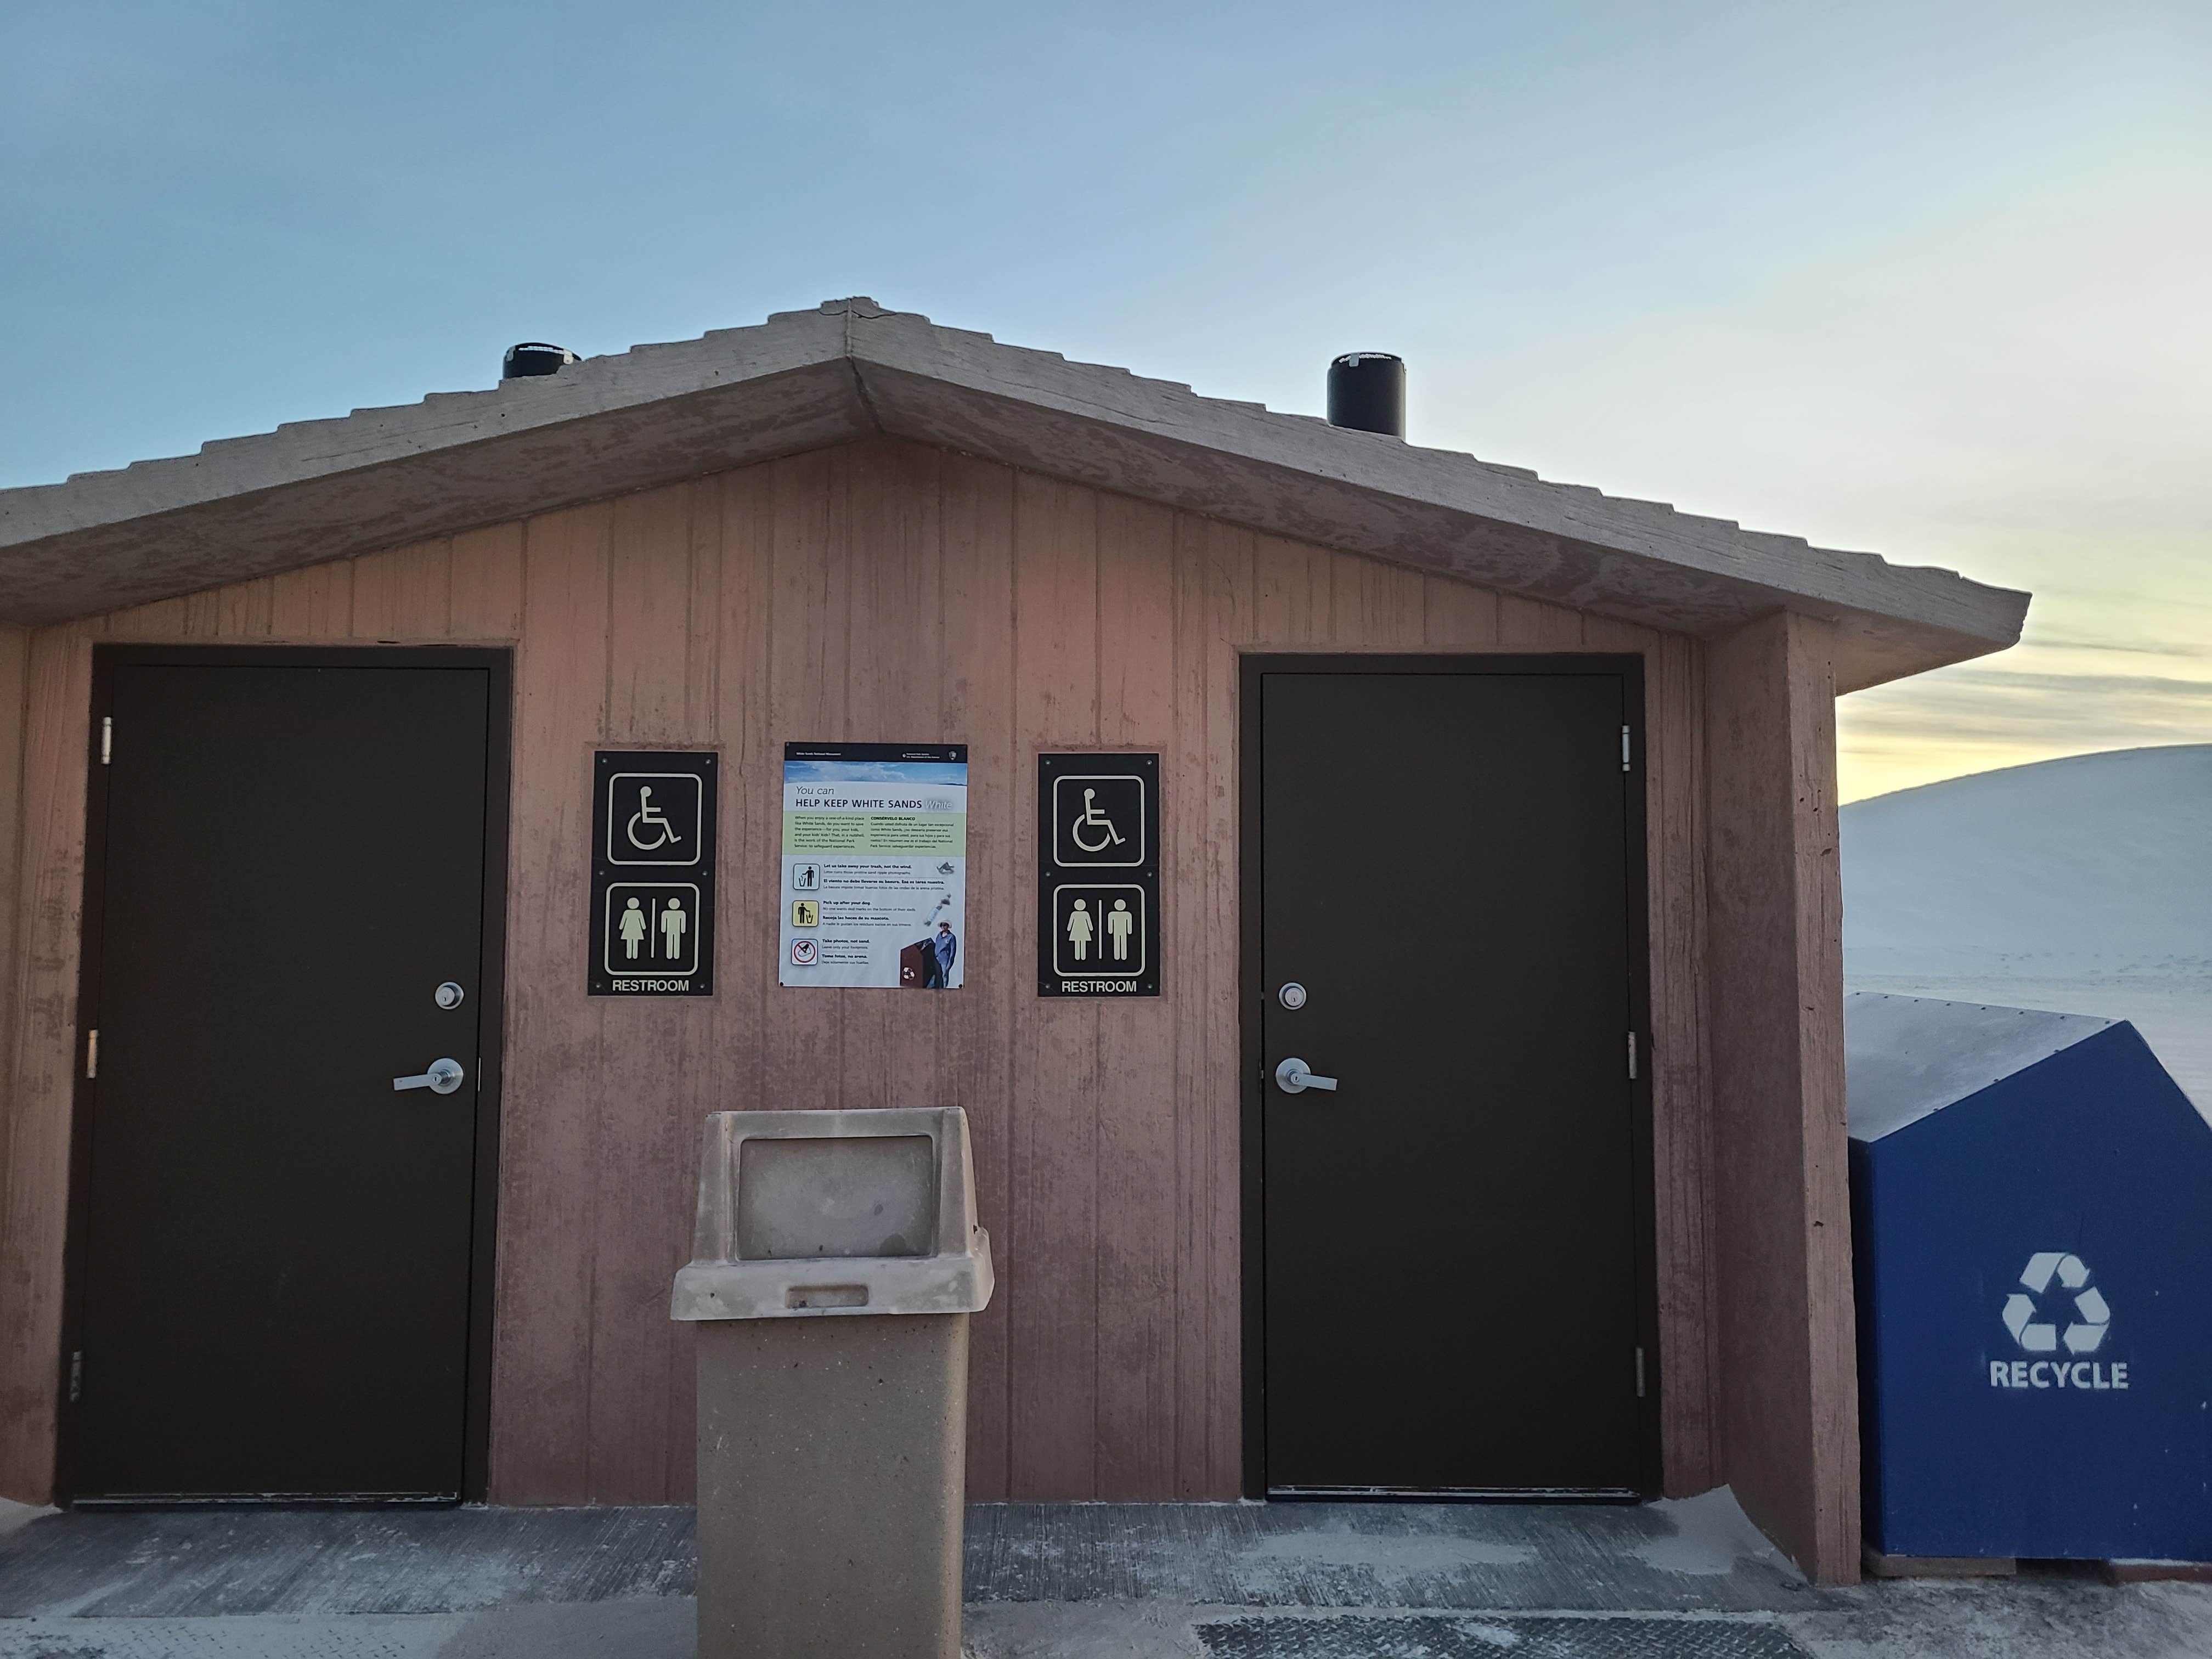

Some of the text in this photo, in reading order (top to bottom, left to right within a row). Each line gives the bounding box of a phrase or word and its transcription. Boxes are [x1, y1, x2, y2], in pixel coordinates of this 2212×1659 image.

[797, 786, 814, 794] You
[796, 799, 952, 809] HELP KEEP WHITE SANDS White
[612, 980, 689, 991] RESTROOM
[1062, 981, 1137, 992] RESTROOM
[1990, 1361, 2129, 1389] RECYCLE
